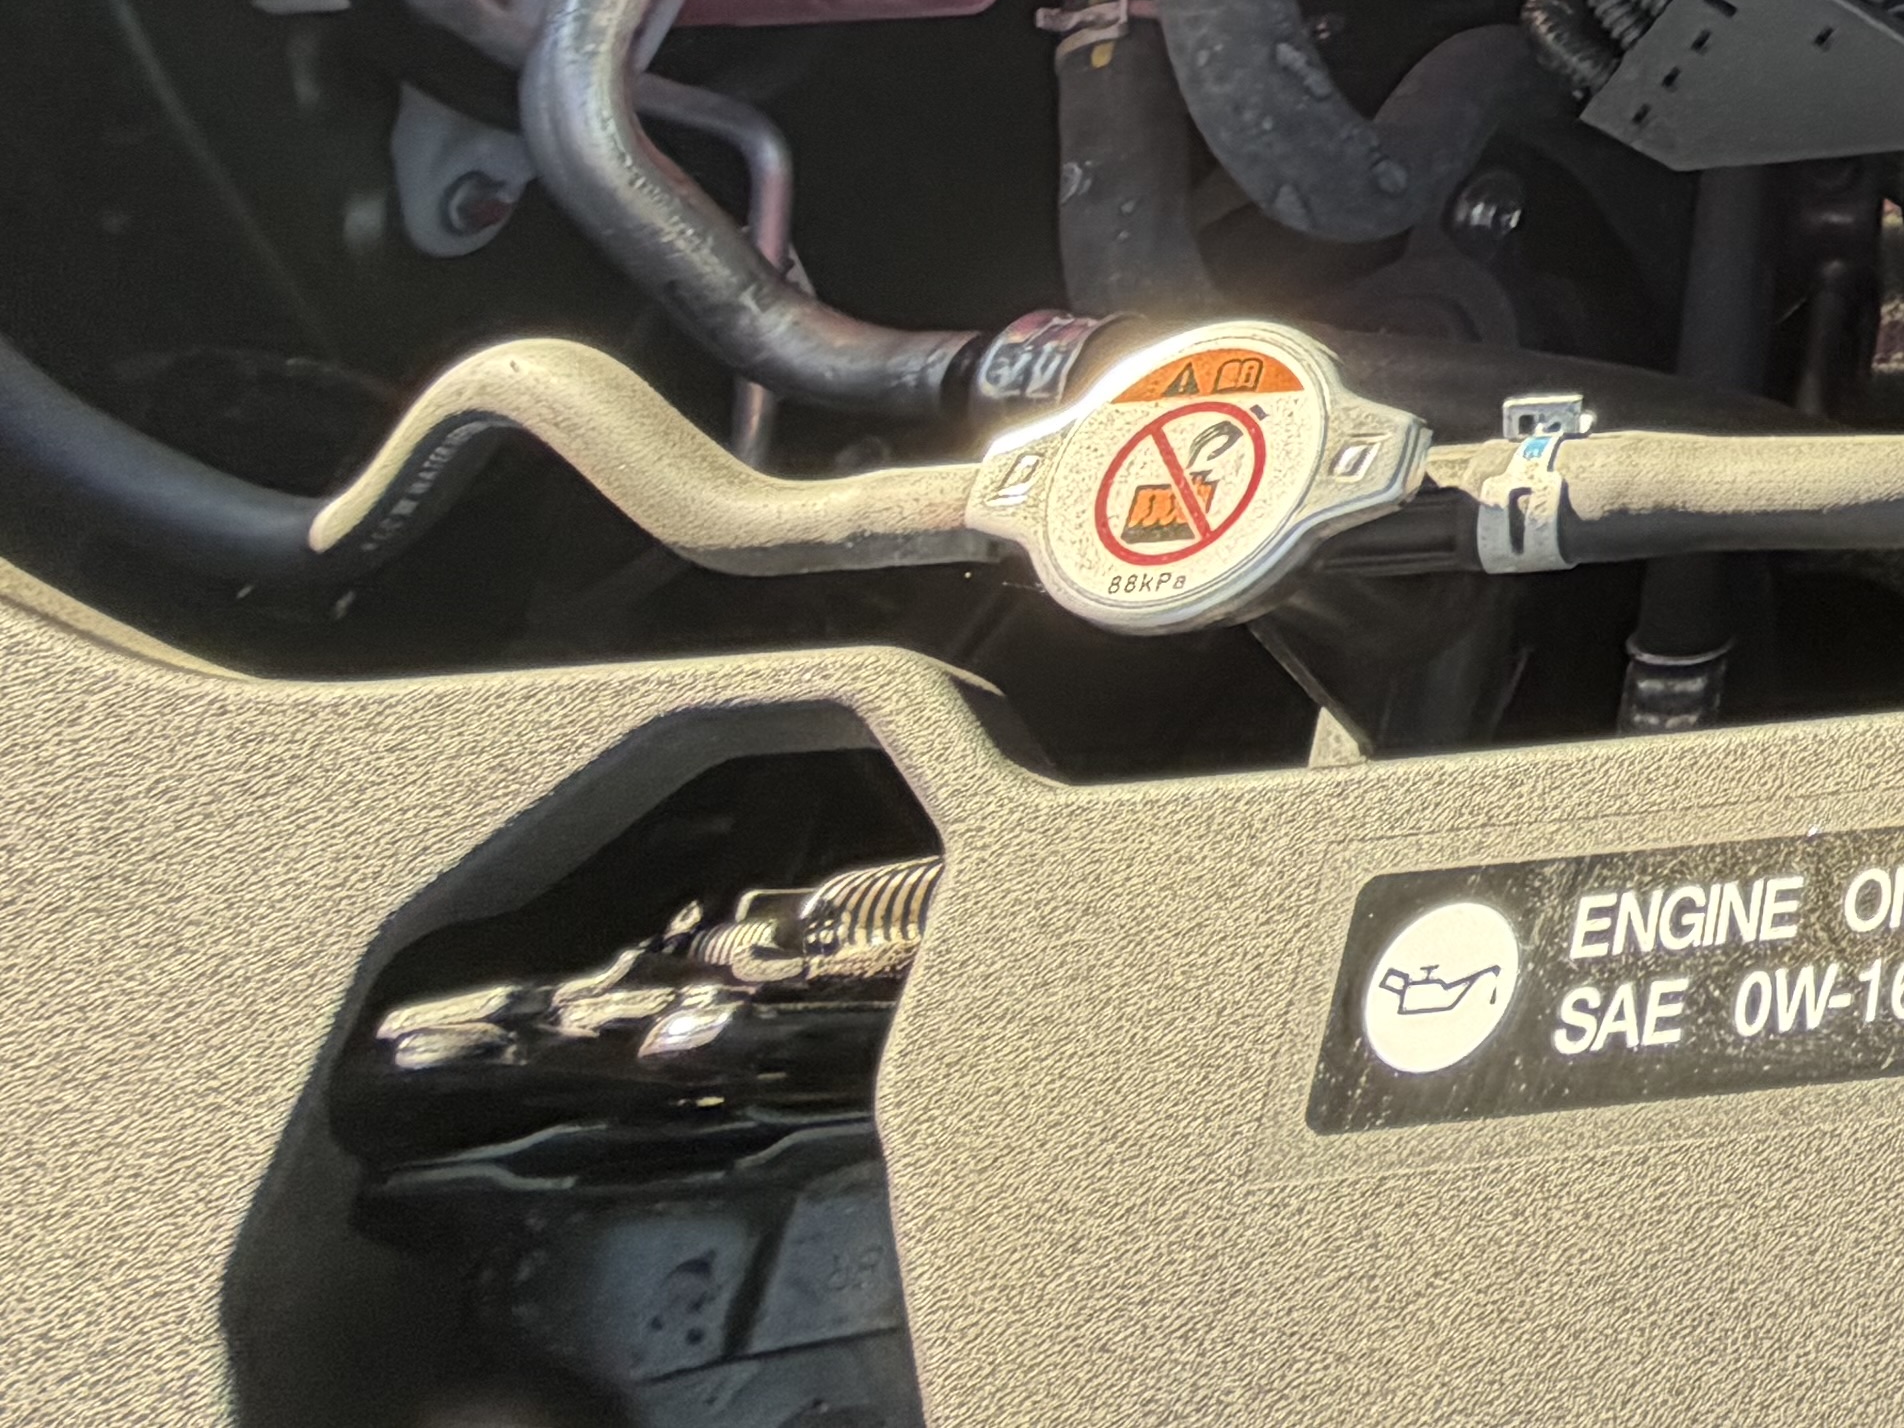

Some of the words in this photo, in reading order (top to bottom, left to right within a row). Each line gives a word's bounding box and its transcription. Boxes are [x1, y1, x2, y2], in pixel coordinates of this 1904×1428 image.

[1107, 572, 1187, 595] 88kPa
[1569, 875, 1804, 960] ENGINE
[1553, 978, 1689, 1055] SAE
